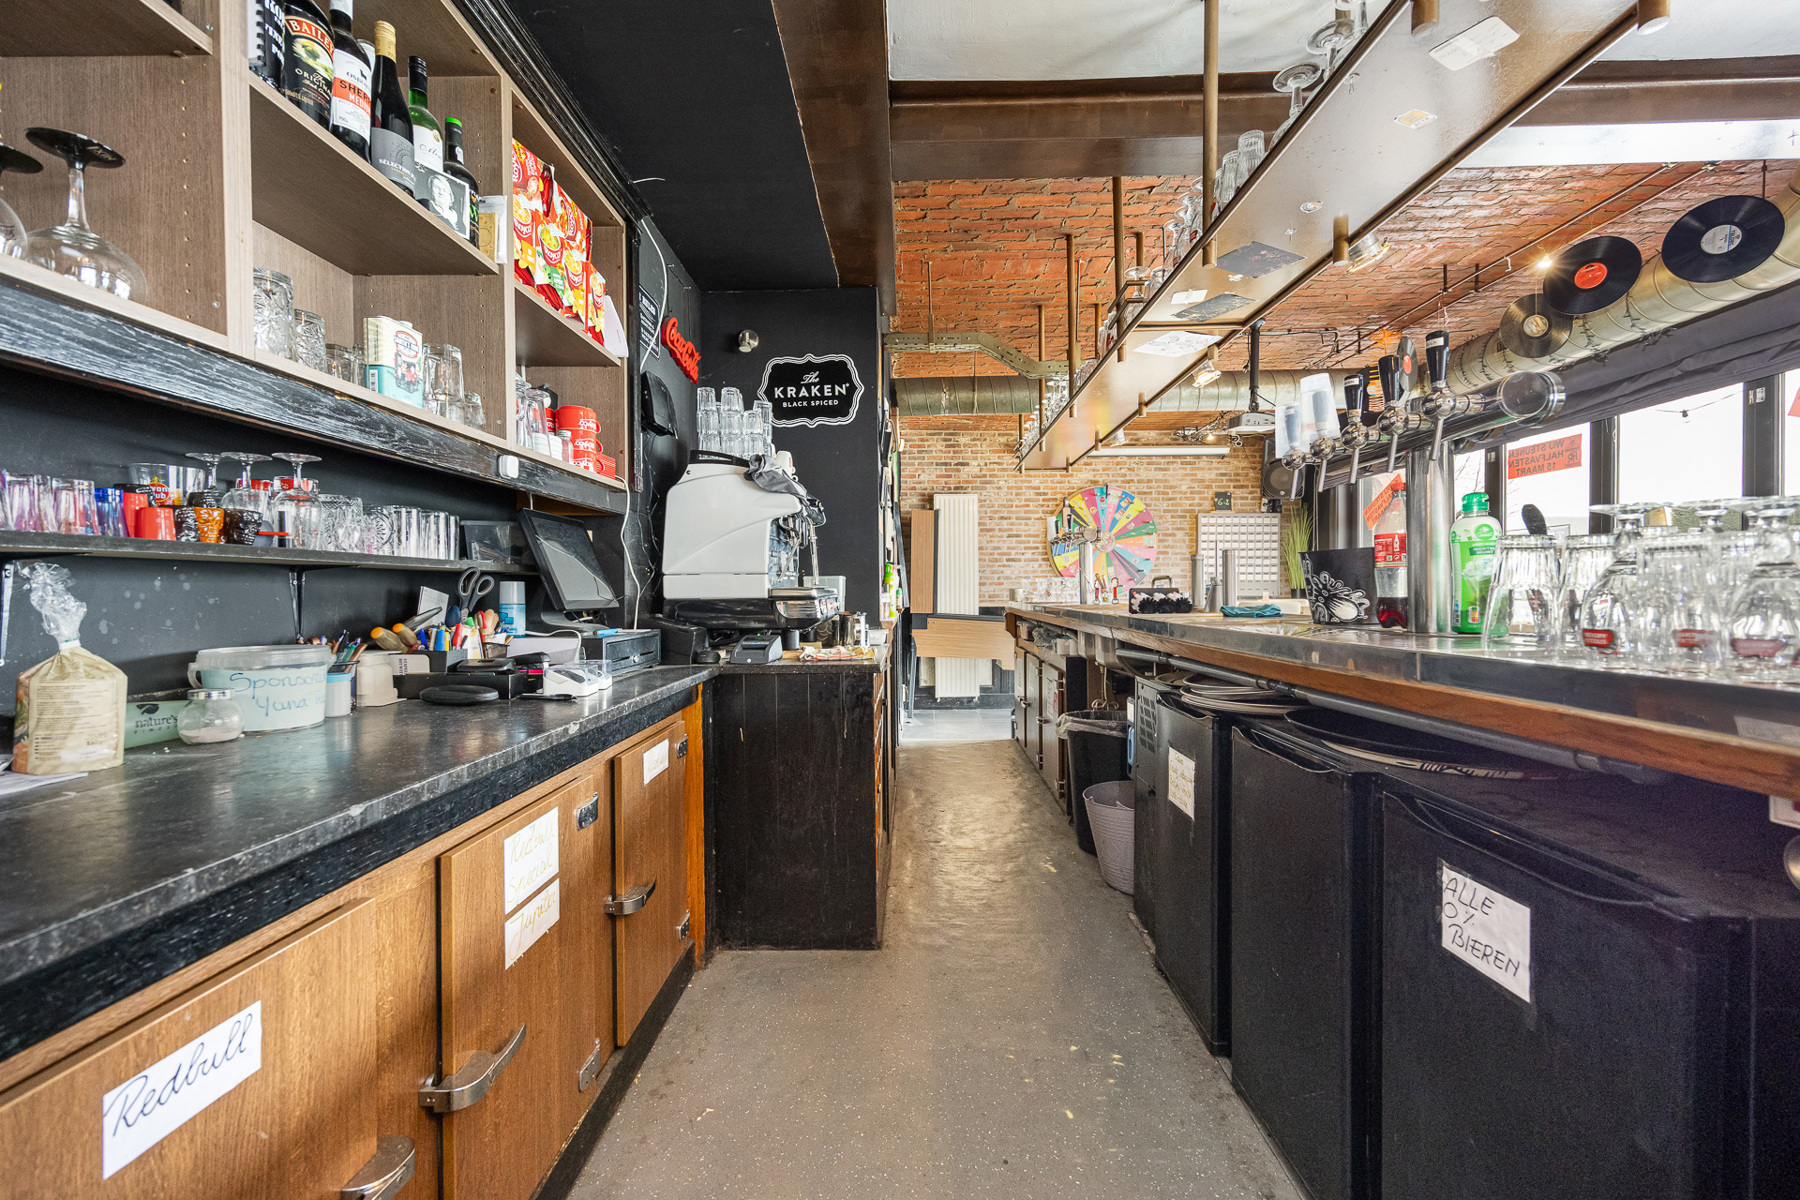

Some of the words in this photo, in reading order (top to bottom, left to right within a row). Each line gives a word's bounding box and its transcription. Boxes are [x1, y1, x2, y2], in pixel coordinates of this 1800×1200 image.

[774, 383, 848, 399] KRAKEN
[801, 370, 820, 384] The
[1443, 877, 1495, 916] ALLE
[1448, 923, 1521, 977] BIEREN
[103, 1013, 254, 1138] Redbull
